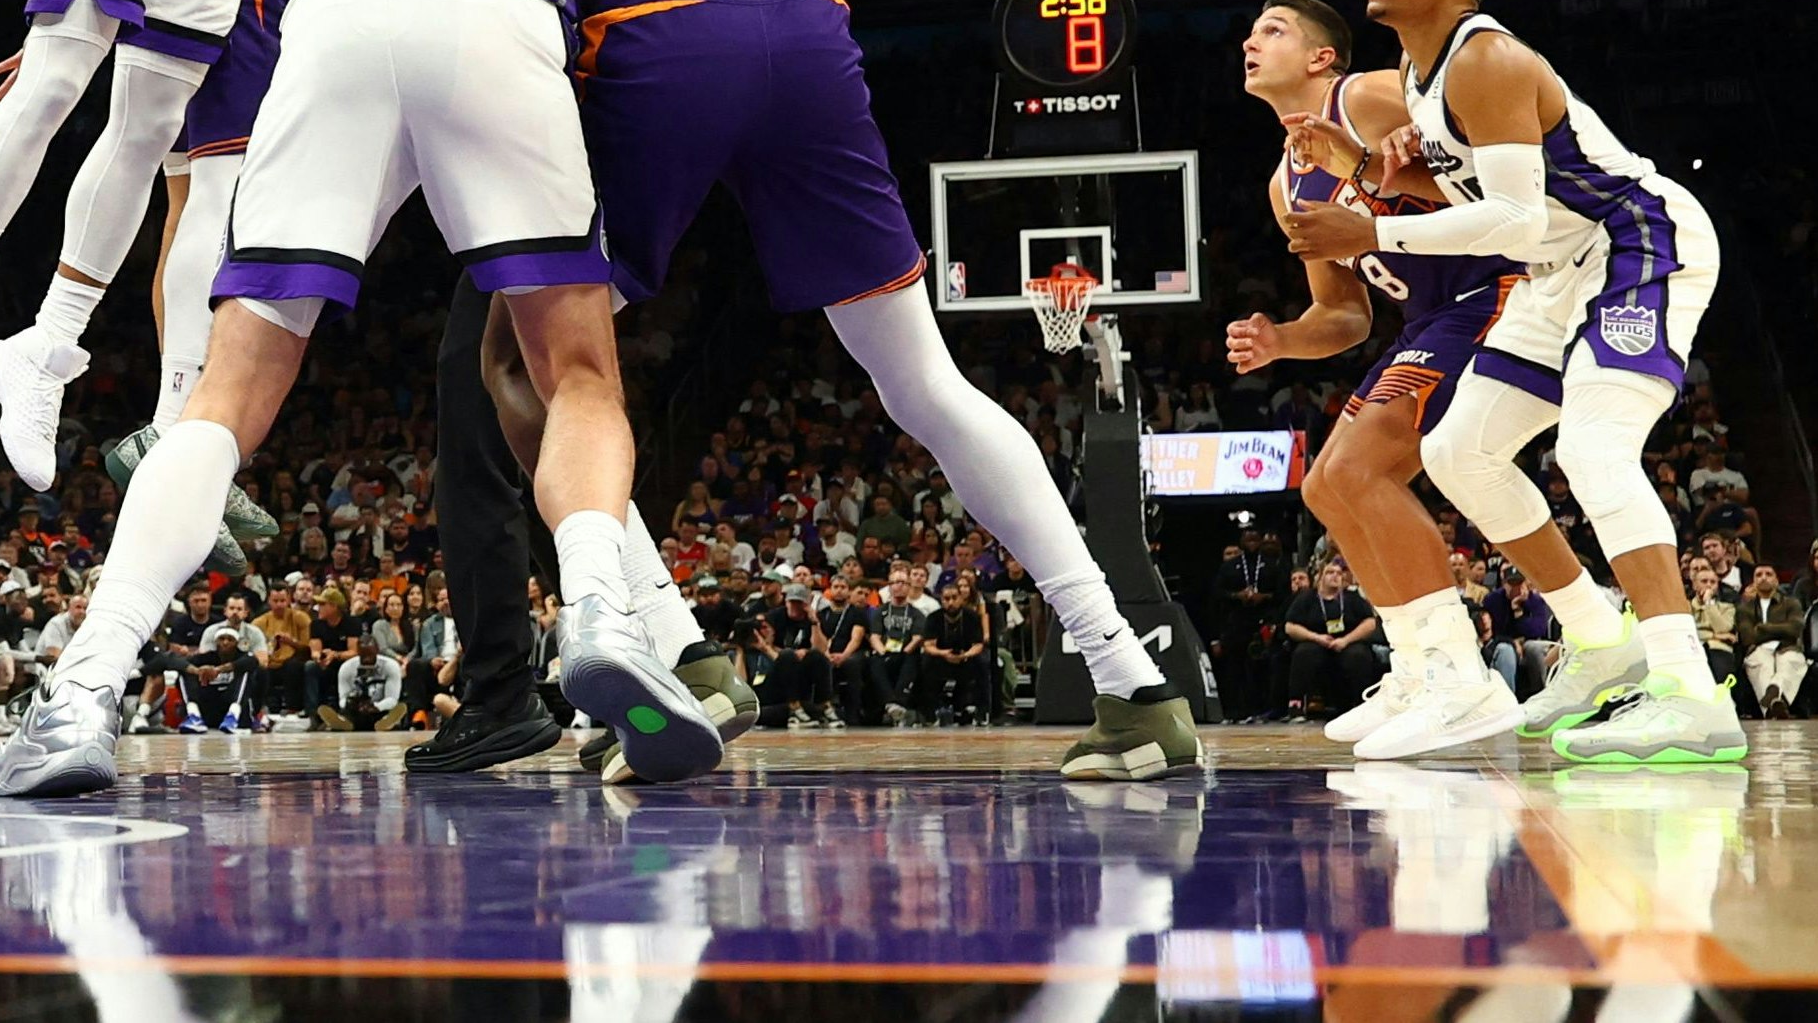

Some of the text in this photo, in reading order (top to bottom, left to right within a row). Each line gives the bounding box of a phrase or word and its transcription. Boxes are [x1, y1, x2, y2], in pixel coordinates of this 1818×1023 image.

[1068, 16, 1103, 73] 8
[1042, 94, 1121, 113] TISSOT
[1604, 323, 1653, 339] KINGS
[1224, 436, 1286, 466] JIM BEAM
